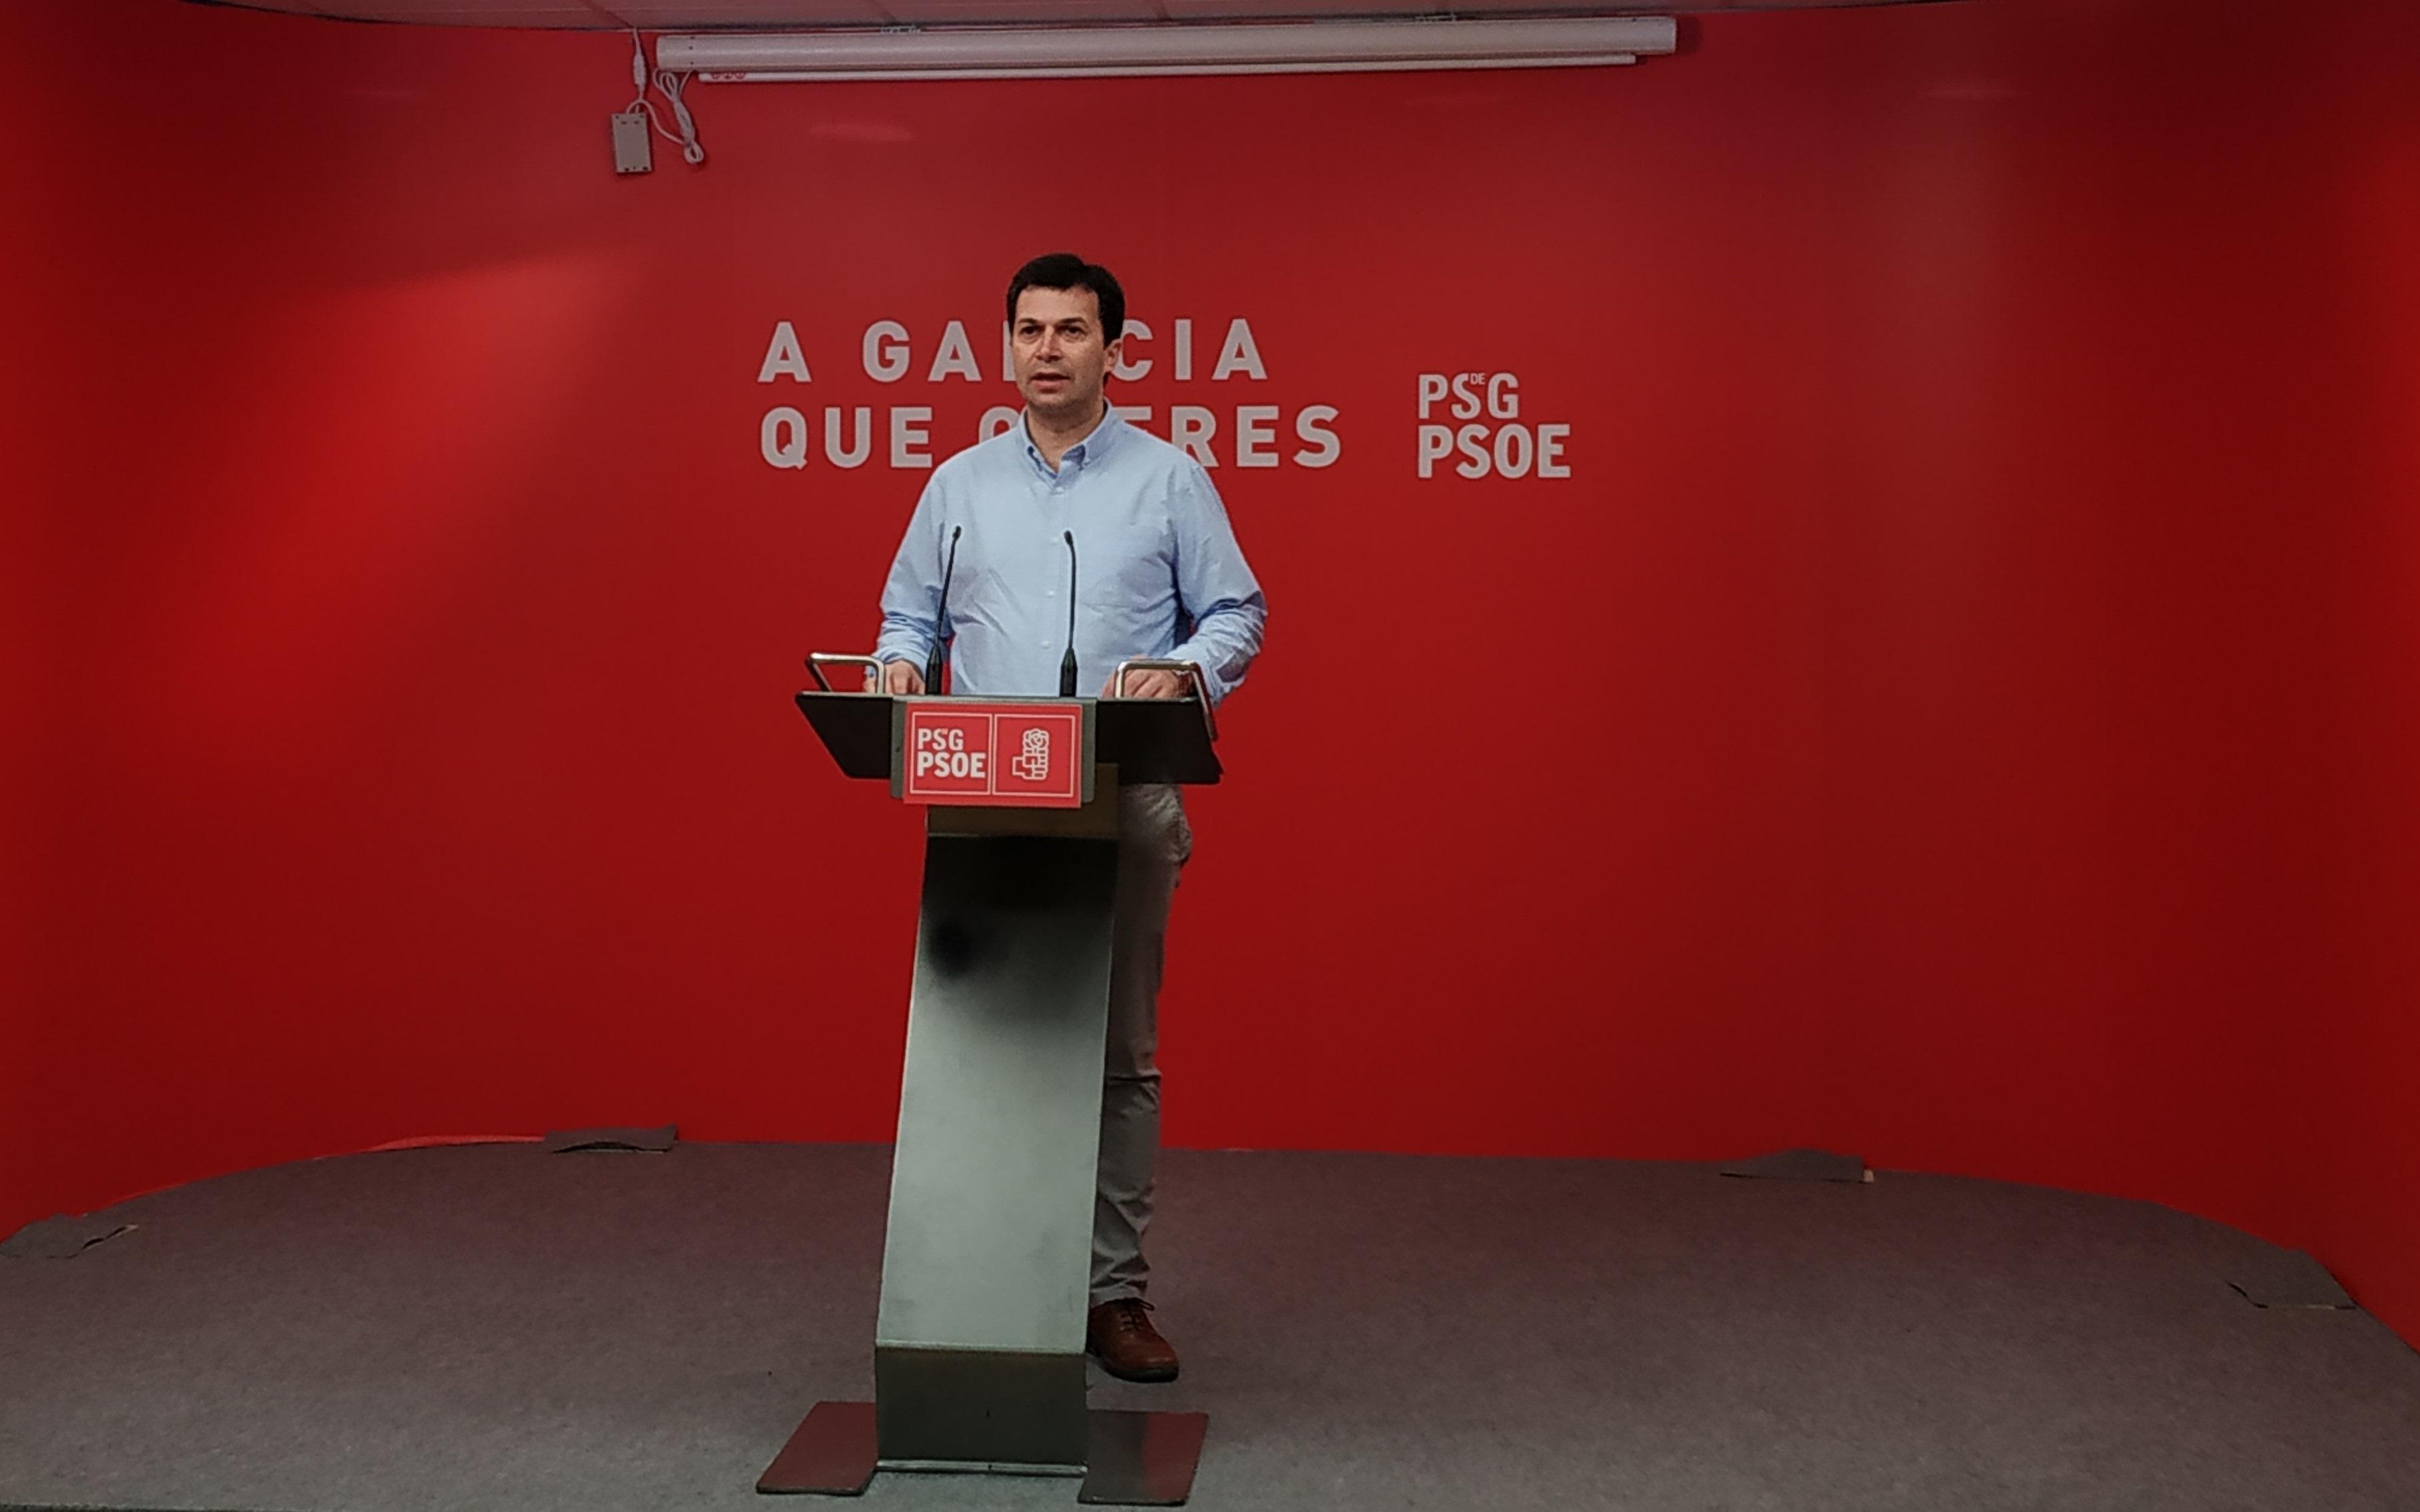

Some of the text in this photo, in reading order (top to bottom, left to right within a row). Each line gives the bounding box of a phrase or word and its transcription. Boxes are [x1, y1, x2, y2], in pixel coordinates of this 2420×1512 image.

[758, 318, 1268, 383] A GACIA
[761, 406, 932, 470] QUE
[1418, 423, 1571, 479] PSOE
[917, 751, 986, 778] PSOE
